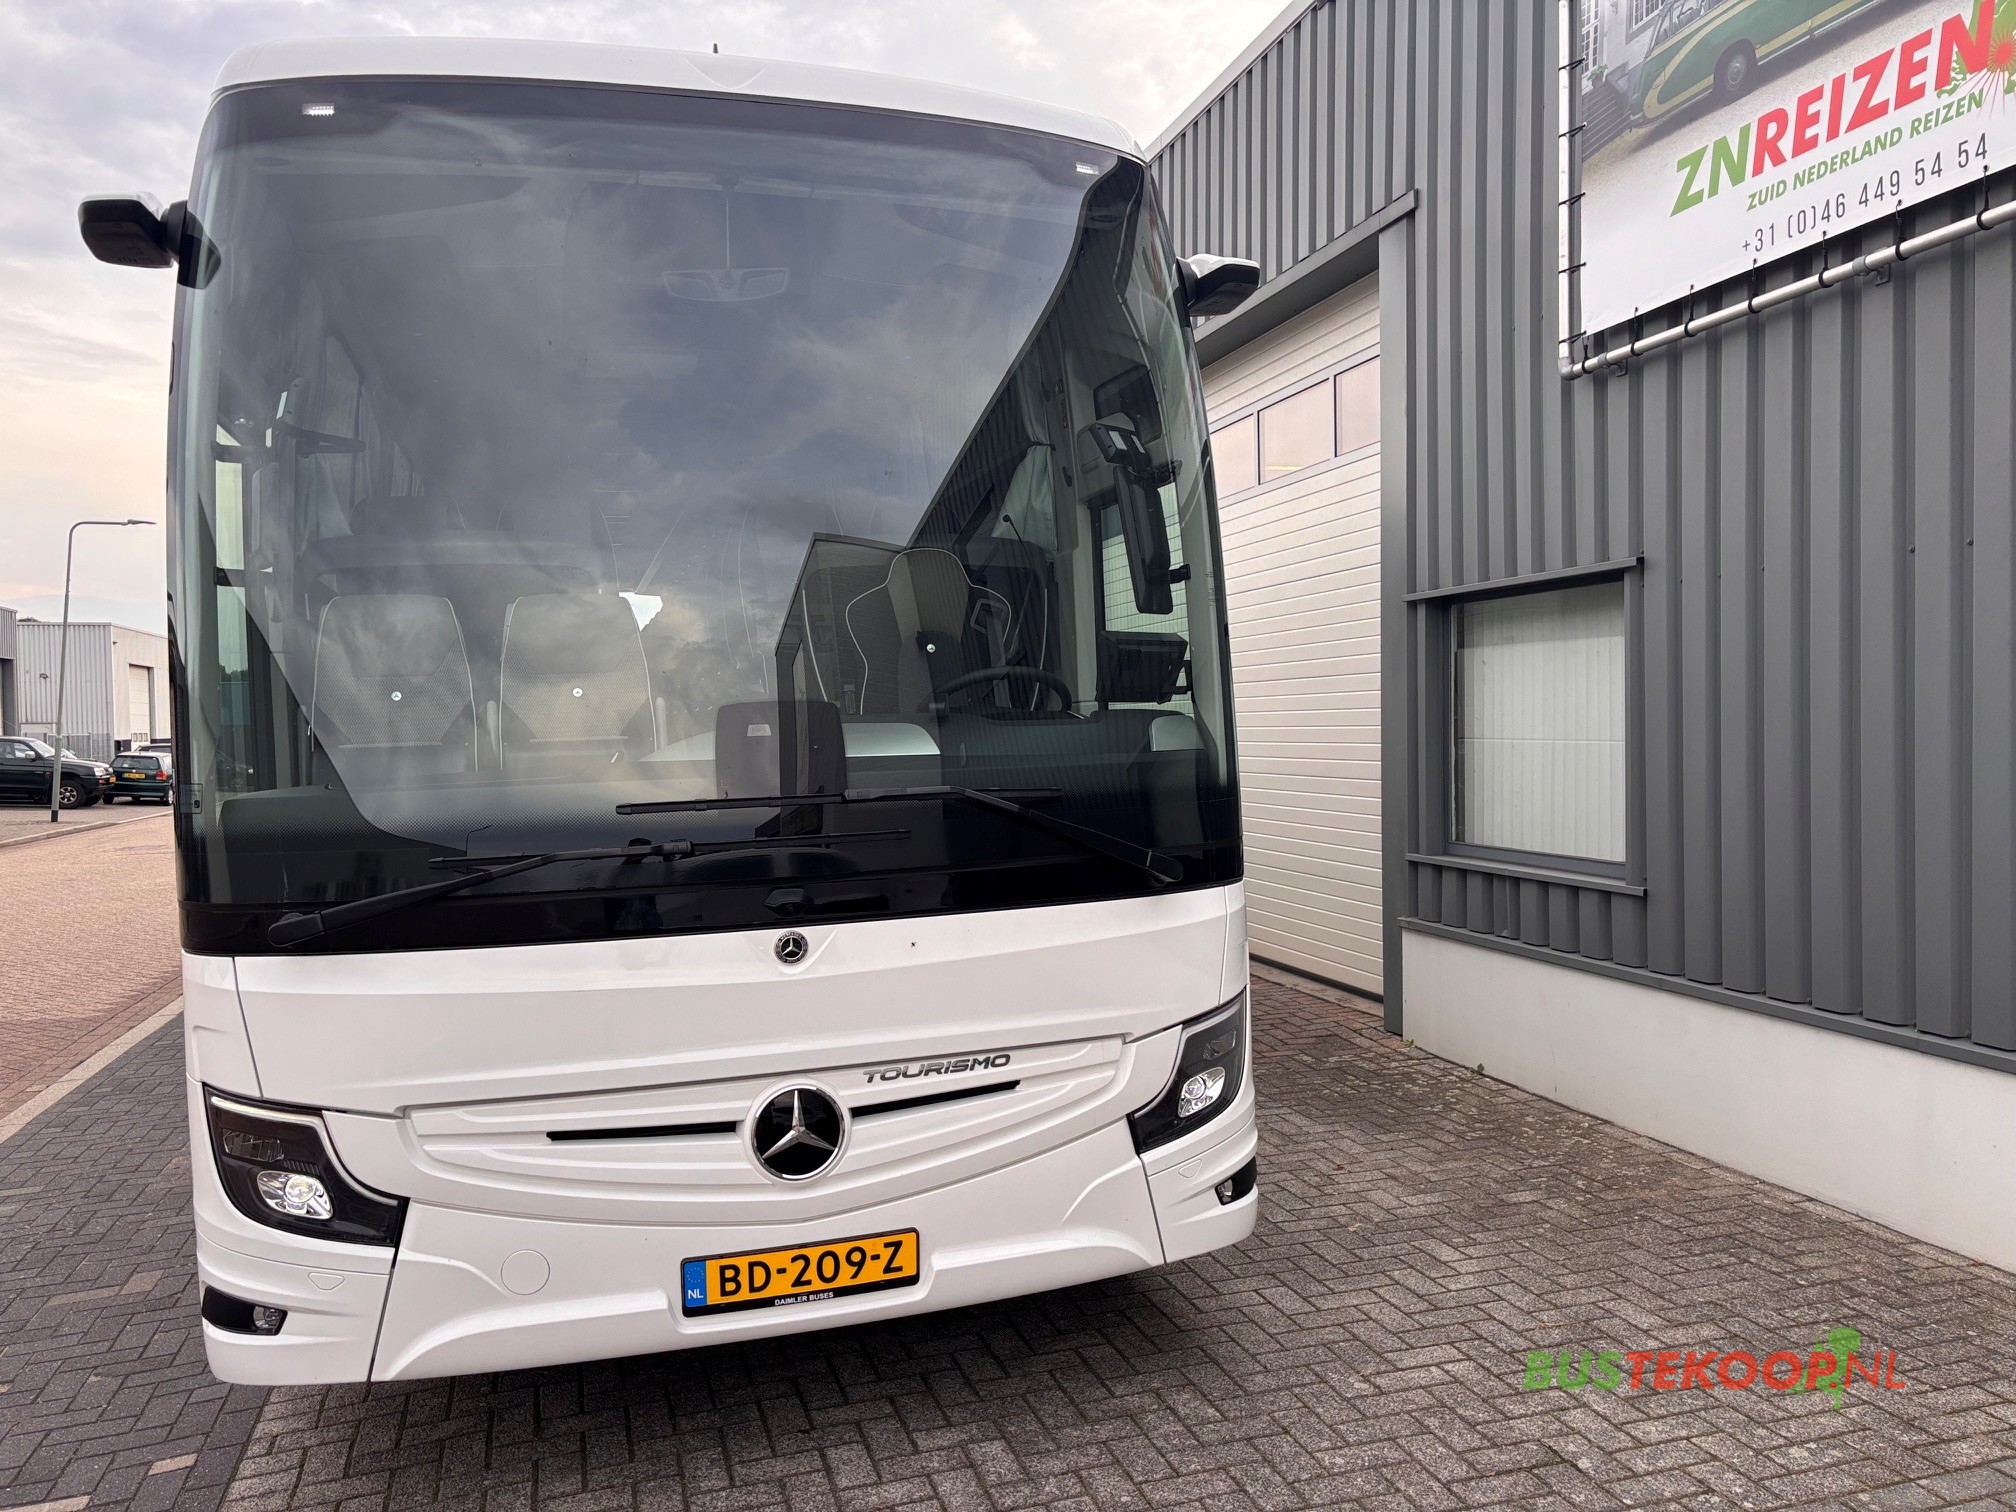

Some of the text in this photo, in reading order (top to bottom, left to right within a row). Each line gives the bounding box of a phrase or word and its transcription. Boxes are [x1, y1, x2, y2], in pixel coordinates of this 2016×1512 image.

[1746, 89, 1985, 212] ZUID NEDERLAND REIZEN
[1742, 133, 1988, 252] +31 (0)46 449 54 54
[864, 1054, 1011, 1083] TOURISMO
[719, 1240, 904, 1297] BD-209-Z
[688, 1289, 704, 1299] NL
[774, 1291, 834, 1306] DAIMLER BUSES
